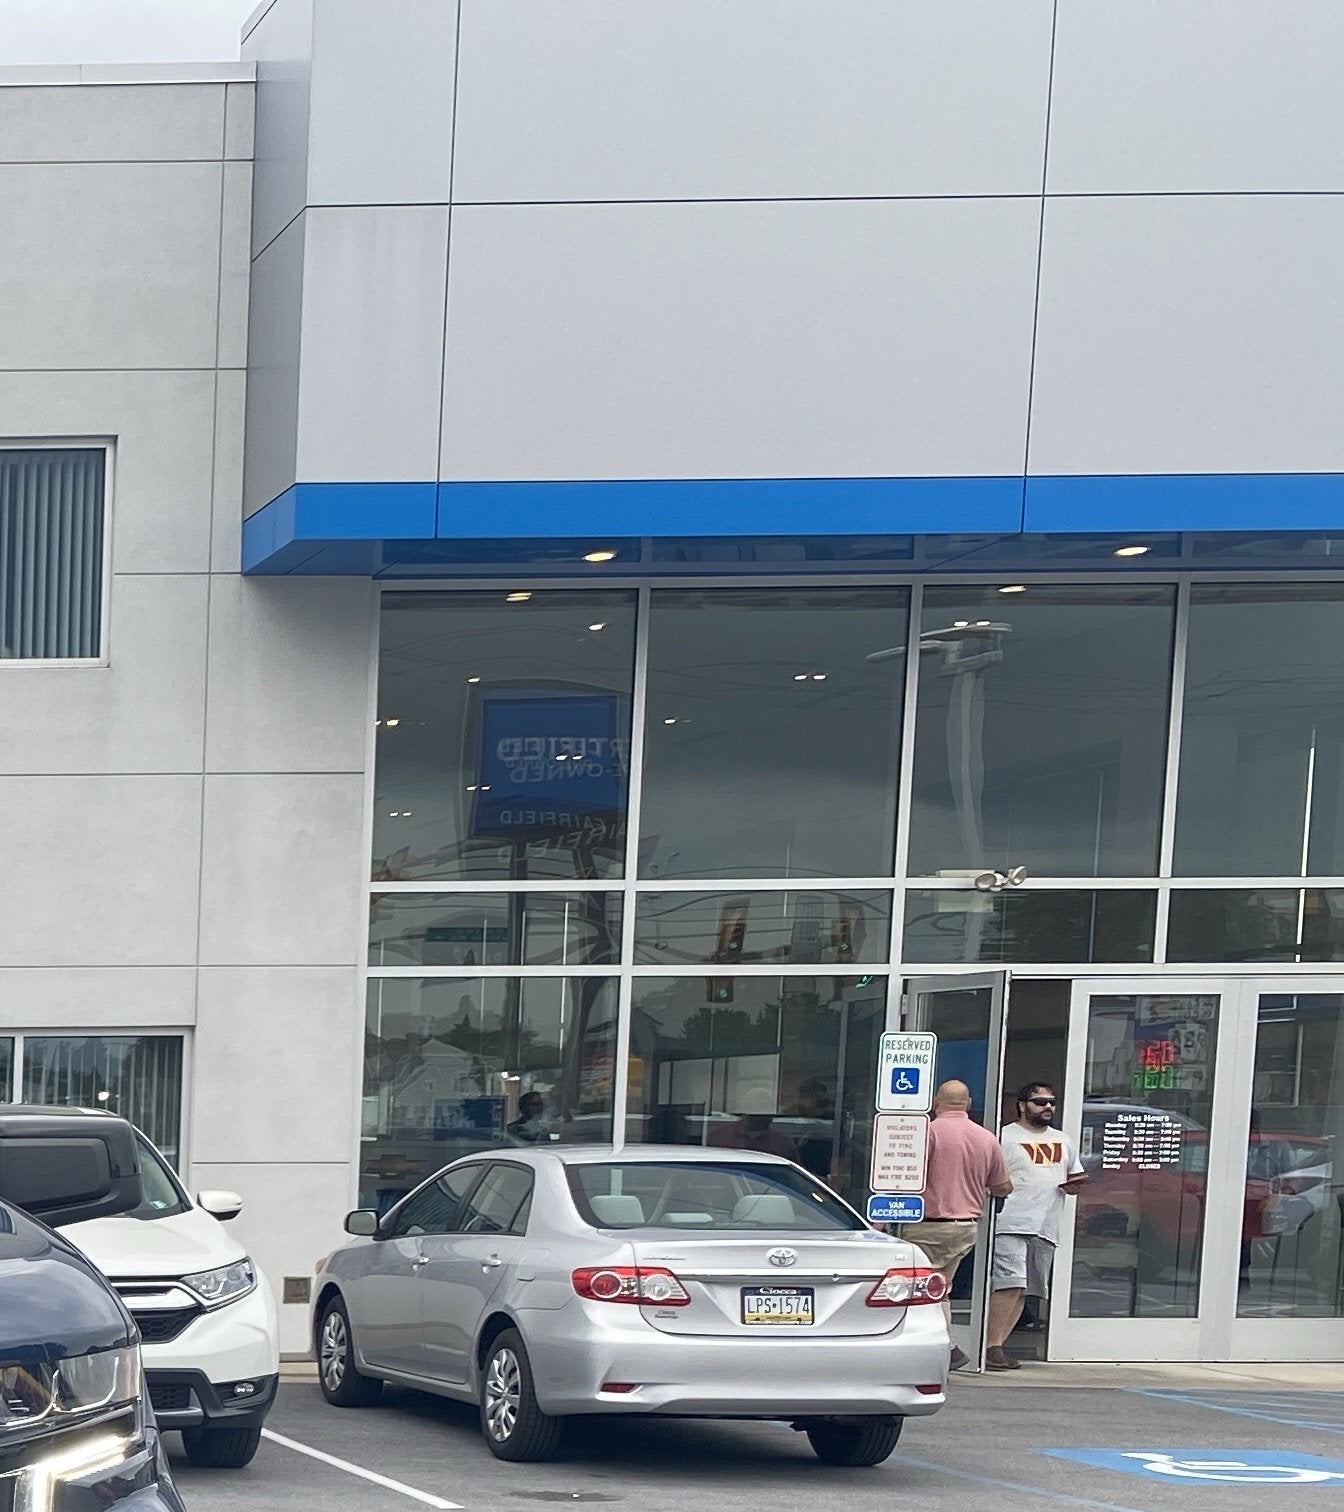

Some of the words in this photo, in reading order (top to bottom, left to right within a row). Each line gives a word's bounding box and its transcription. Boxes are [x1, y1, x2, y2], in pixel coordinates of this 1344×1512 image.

[885, 1039, 931, 1051] RESERVED
[885, 1053, 929, 1064] PARKING
[1117, 1114, 1142, 1122] Sales
[1143, 1114, 1170, 1122] Hours
[888, 1201, 906, 1209] VAN
[871, 1208, 921, 1217] ACCESSIBLE
